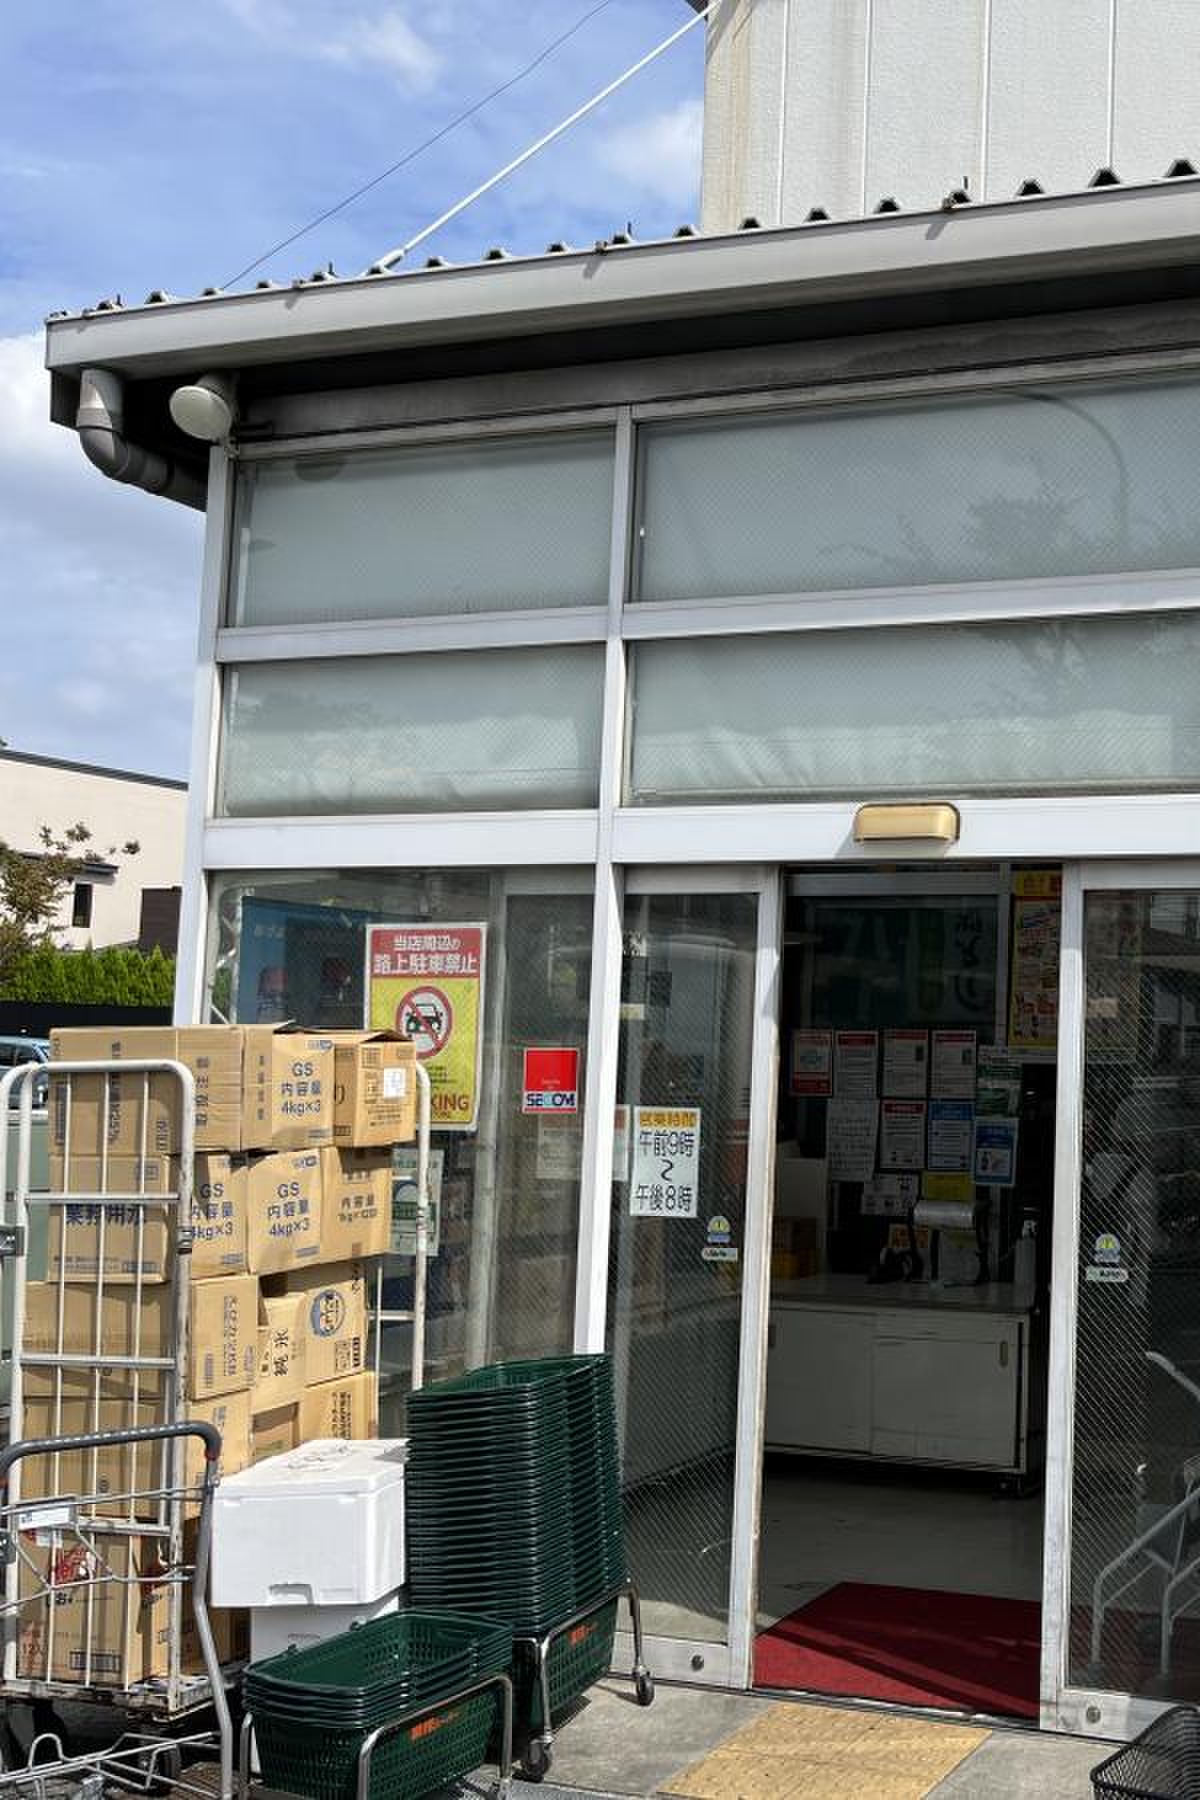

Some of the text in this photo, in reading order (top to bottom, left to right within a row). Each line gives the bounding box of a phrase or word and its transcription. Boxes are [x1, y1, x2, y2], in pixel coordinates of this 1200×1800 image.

[373, 952, 478, 975] 路上駐車禁止
[292, 1062, 314, 1077] GS
[526, 1093, 575, 1106] SECOM
[639, 1131, 695, 1158] 午前9時
[200, 1183, 224, 1198] GS
[277, 1182, 300, 1198] GS
[634, 1185, 693, 1212] 午後8時
